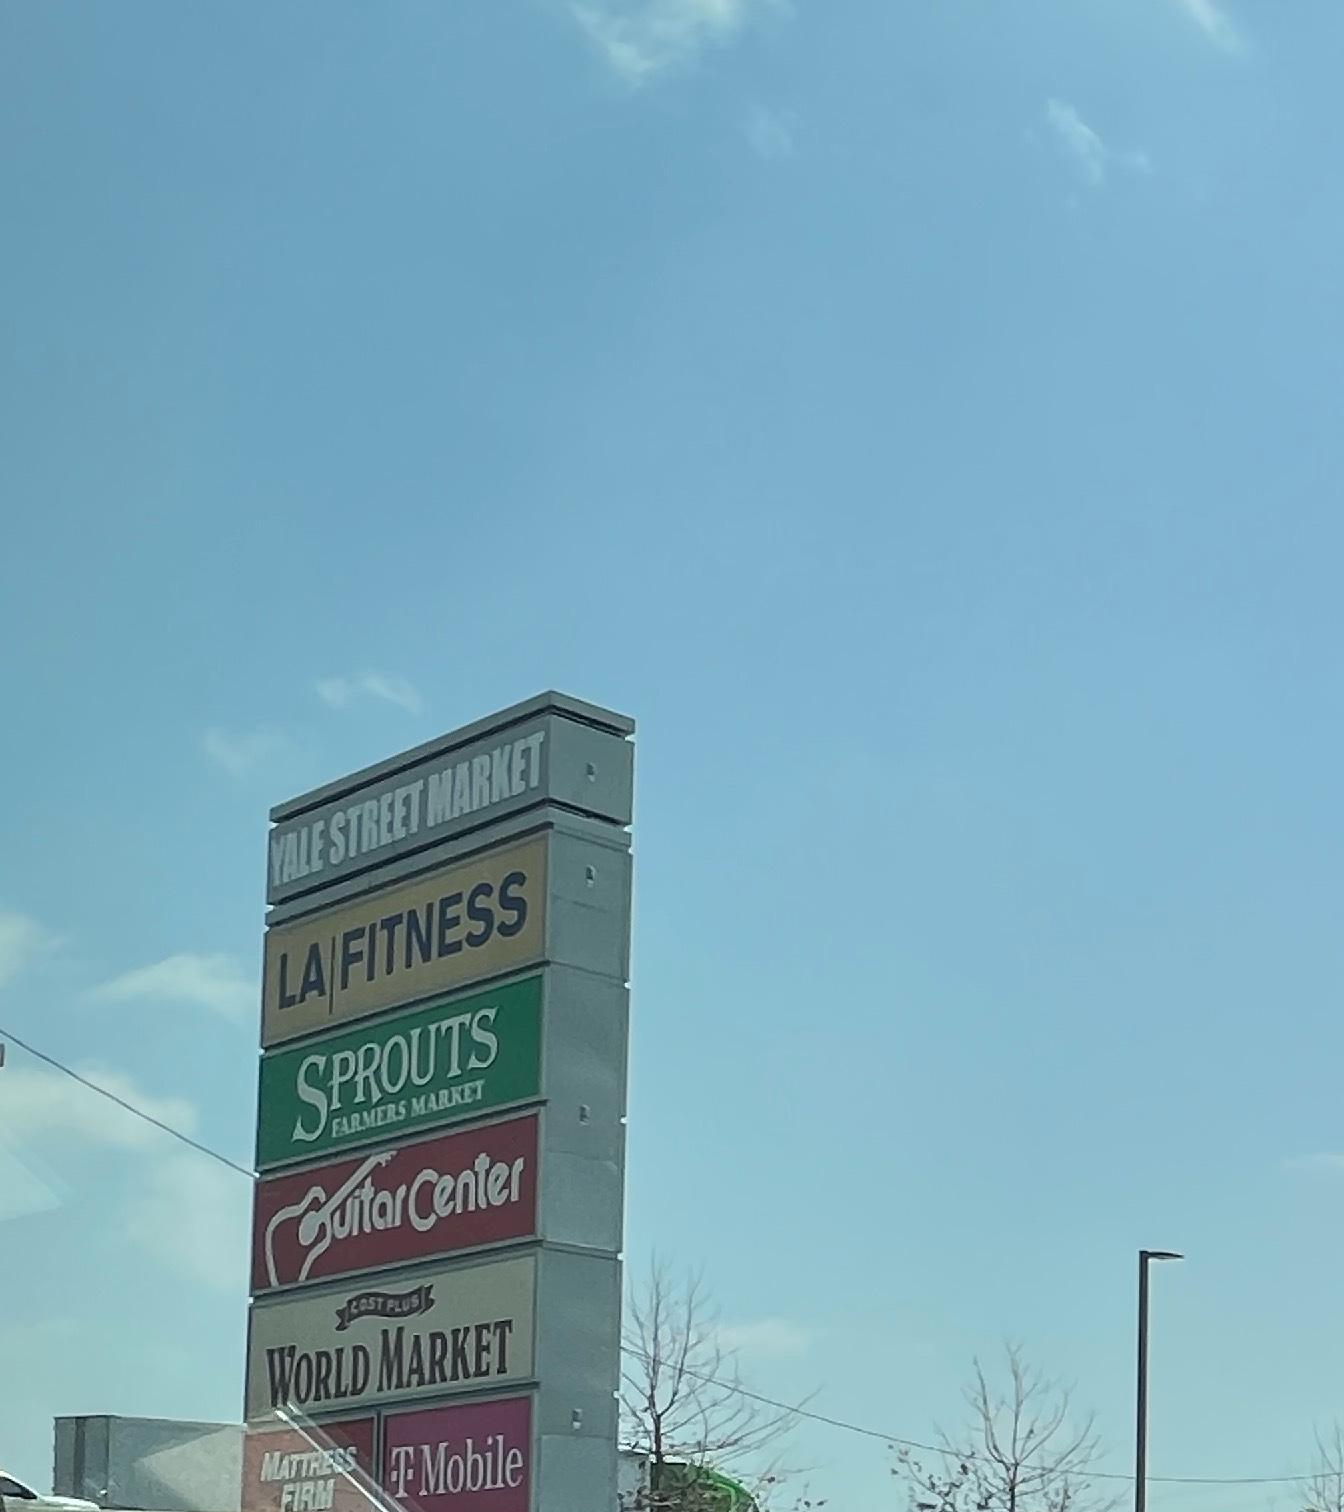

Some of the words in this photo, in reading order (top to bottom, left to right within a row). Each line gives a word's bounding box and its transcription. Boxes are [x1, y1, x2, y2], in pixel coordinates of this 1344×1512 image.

[270, 820, 326, 888] YALE
[328, 780, 425, 865] STREET
[426, 731, 546, 828] MARKET
[277, 942, 326, 1010] LA
[340, 871, 528, 991] FITNESS
[290, 1007, 500, 1143] SPROUTS
[331, 1099, 407, 1139] FARMERS
[410, 1078, 486, 1118] MARKET
[264, 1150, 407, 1287] Guitar
[408, 1152, 525, 1233] Center
[265, 1344, 371, 1408] WORLD
[377, 1319, 514, 1393] MARKET
[350, 1296, 384, 1315] COST
[386, 1294, 420, 1313] PLUS
